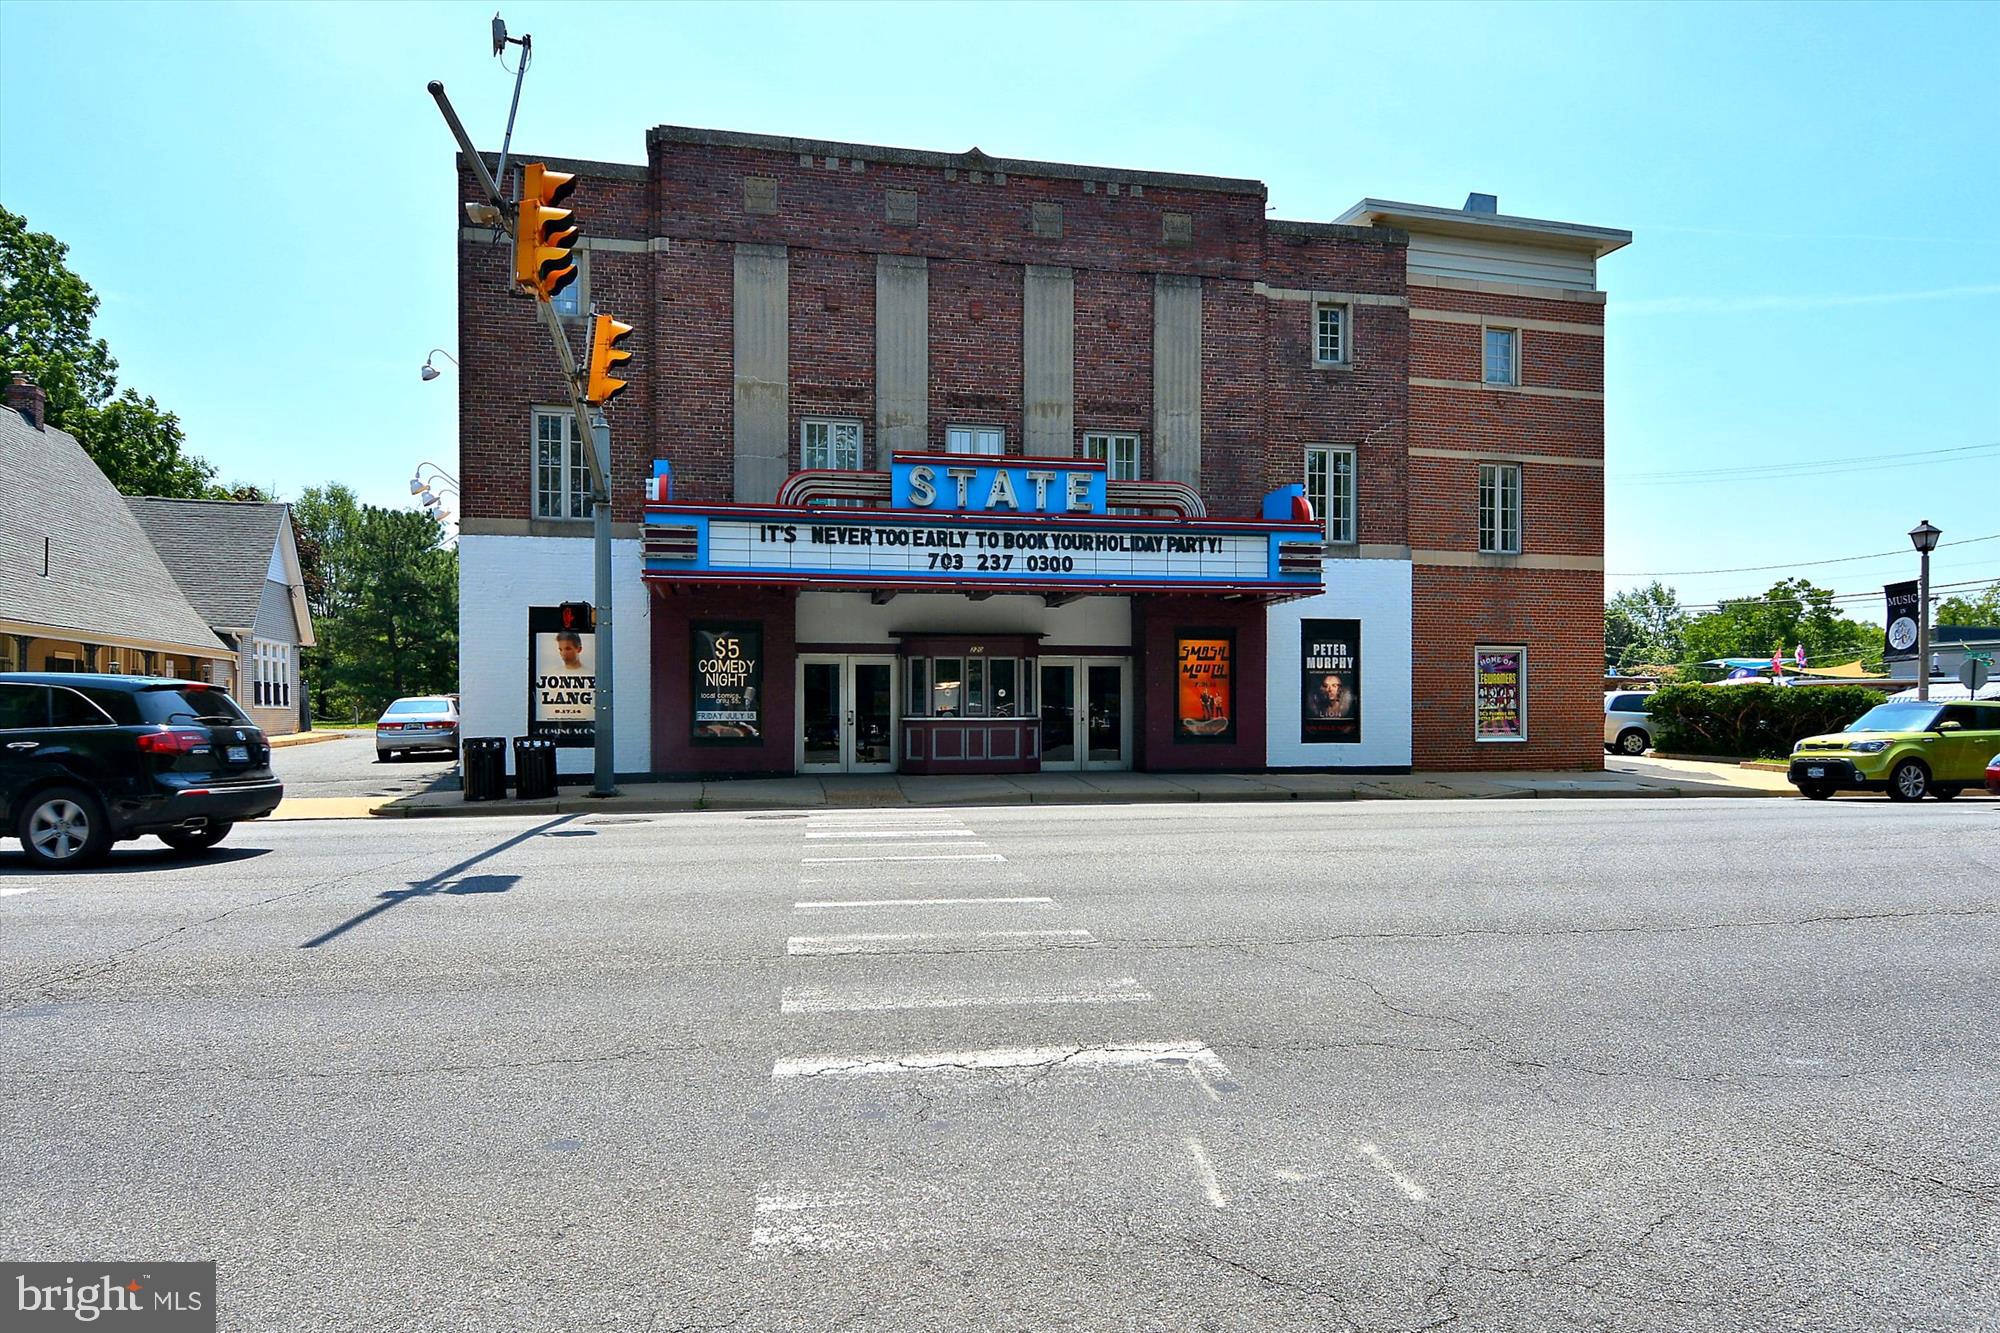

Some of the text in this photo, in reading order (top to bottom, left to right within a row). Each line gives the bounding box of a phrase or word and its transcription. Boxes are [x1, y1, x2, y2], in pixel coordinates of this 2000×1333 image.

[908, 465, 1093, 511] STATE
[760, 525, 1223, 553] IT'S NEVER TOO EARLY TO BOOK YOUR HOLIDAY PARTY!
[928, 553, 1073, 572] 703 237 0300
[1888, 593, 1917, 606] MUSIC
[715, 638, 739, 658] $5
[1179, 646, 1229, 661] SMASH
[1313, 644, 1347, 655] PETER
[698, 660, 755, 673] COMEDY
[1306, 657, 1353, 668] MURPHY
[1480, 656, 1501, 666] HOME
[1183, 664, 1228, 678] MOUTH
[536, 676, 595, 689] JONNY
[705, 673, 747, 686] NIGHT
[542, 692, 592, 704] LANG
[697, 712, 723, 720] FRIDAY
[725, 712, 744, 720] JULY
